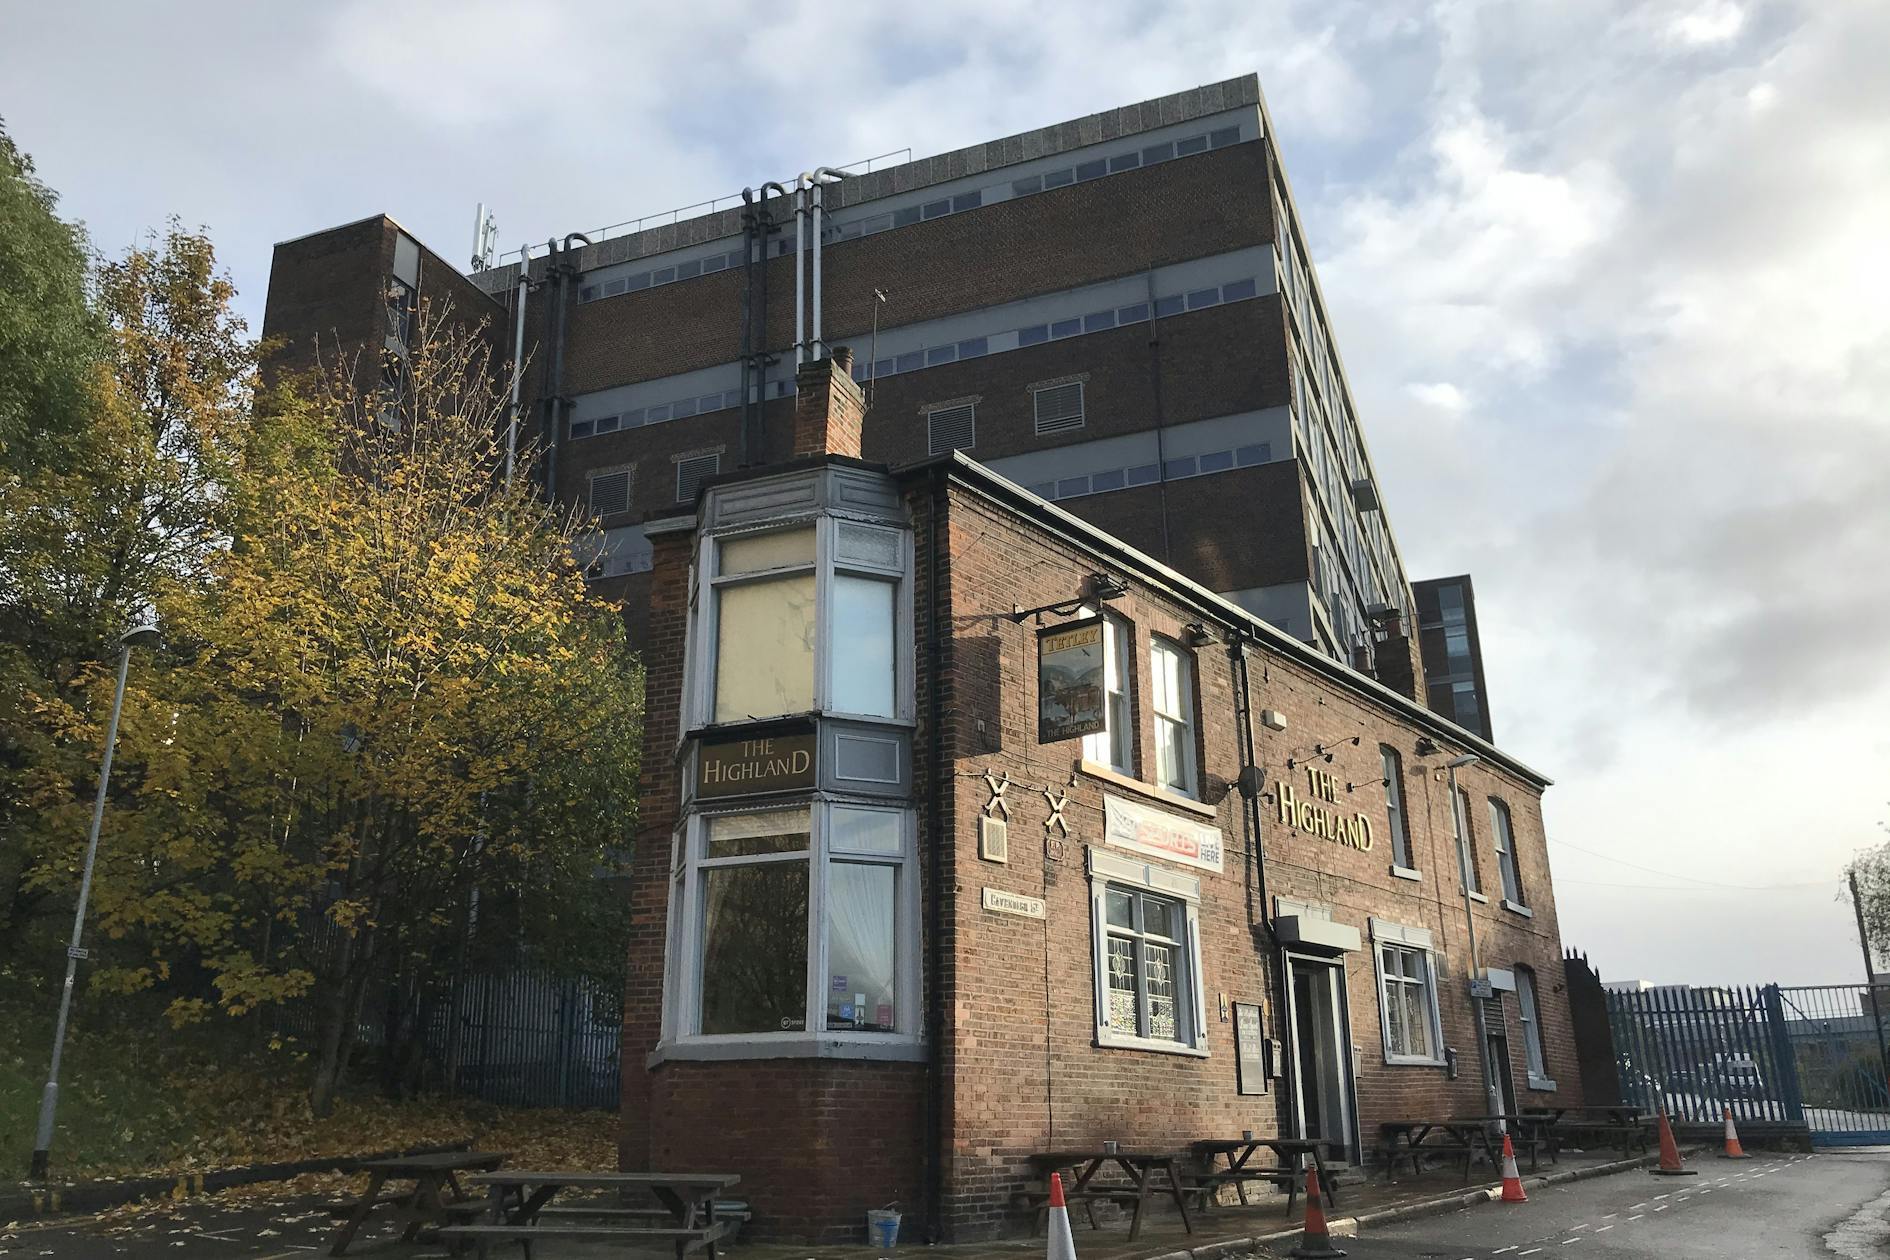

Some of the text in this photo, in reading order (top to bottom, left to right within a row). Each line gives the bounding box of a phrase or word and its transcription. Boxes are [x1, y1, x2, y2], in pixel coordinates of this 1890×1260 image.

[1045, 629, 1099, 652] TETLEY
[1062, 720, 1100, 735] HIGHLAND
[741, 738, 774, 757] THE
[703, 750, 810, 784] HIGHLAND
[1307, 767, 1341, 804] THE
[1277, 781, 1374, 852] HIGHLAND
[1200, 849, 1220, 864] HERE
